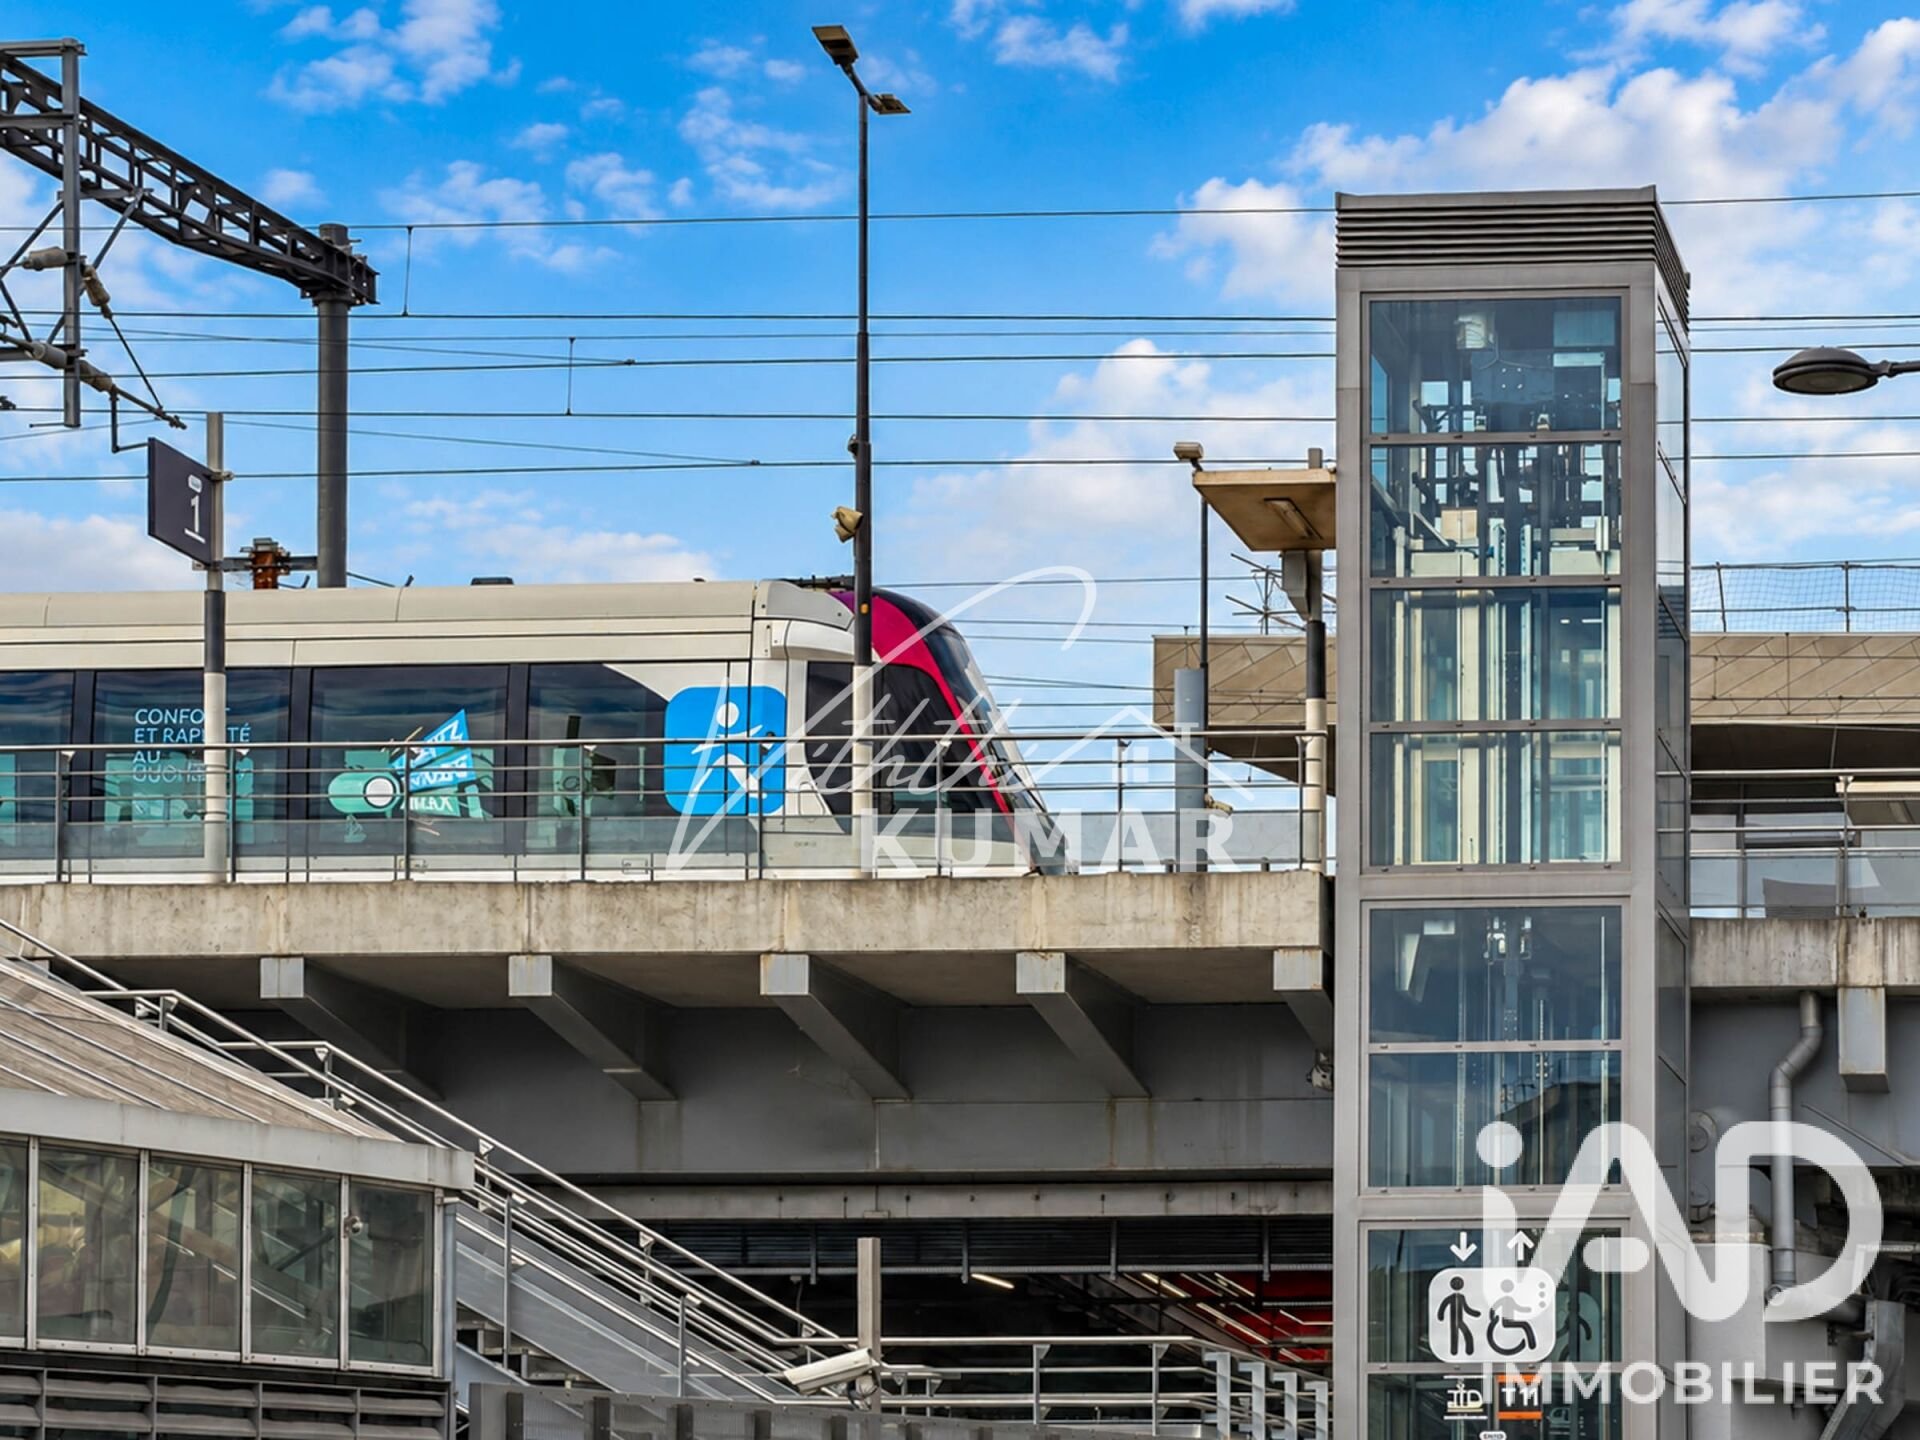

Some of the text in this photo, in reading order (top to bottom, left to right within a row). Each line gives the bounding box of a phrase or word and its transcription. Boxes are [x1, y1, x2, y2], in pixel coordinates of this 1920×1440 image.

[134, 727, 158, 743] ET
[133, 750, 161, 763] AU
[1501, 1386, 1539, 1407] T11
